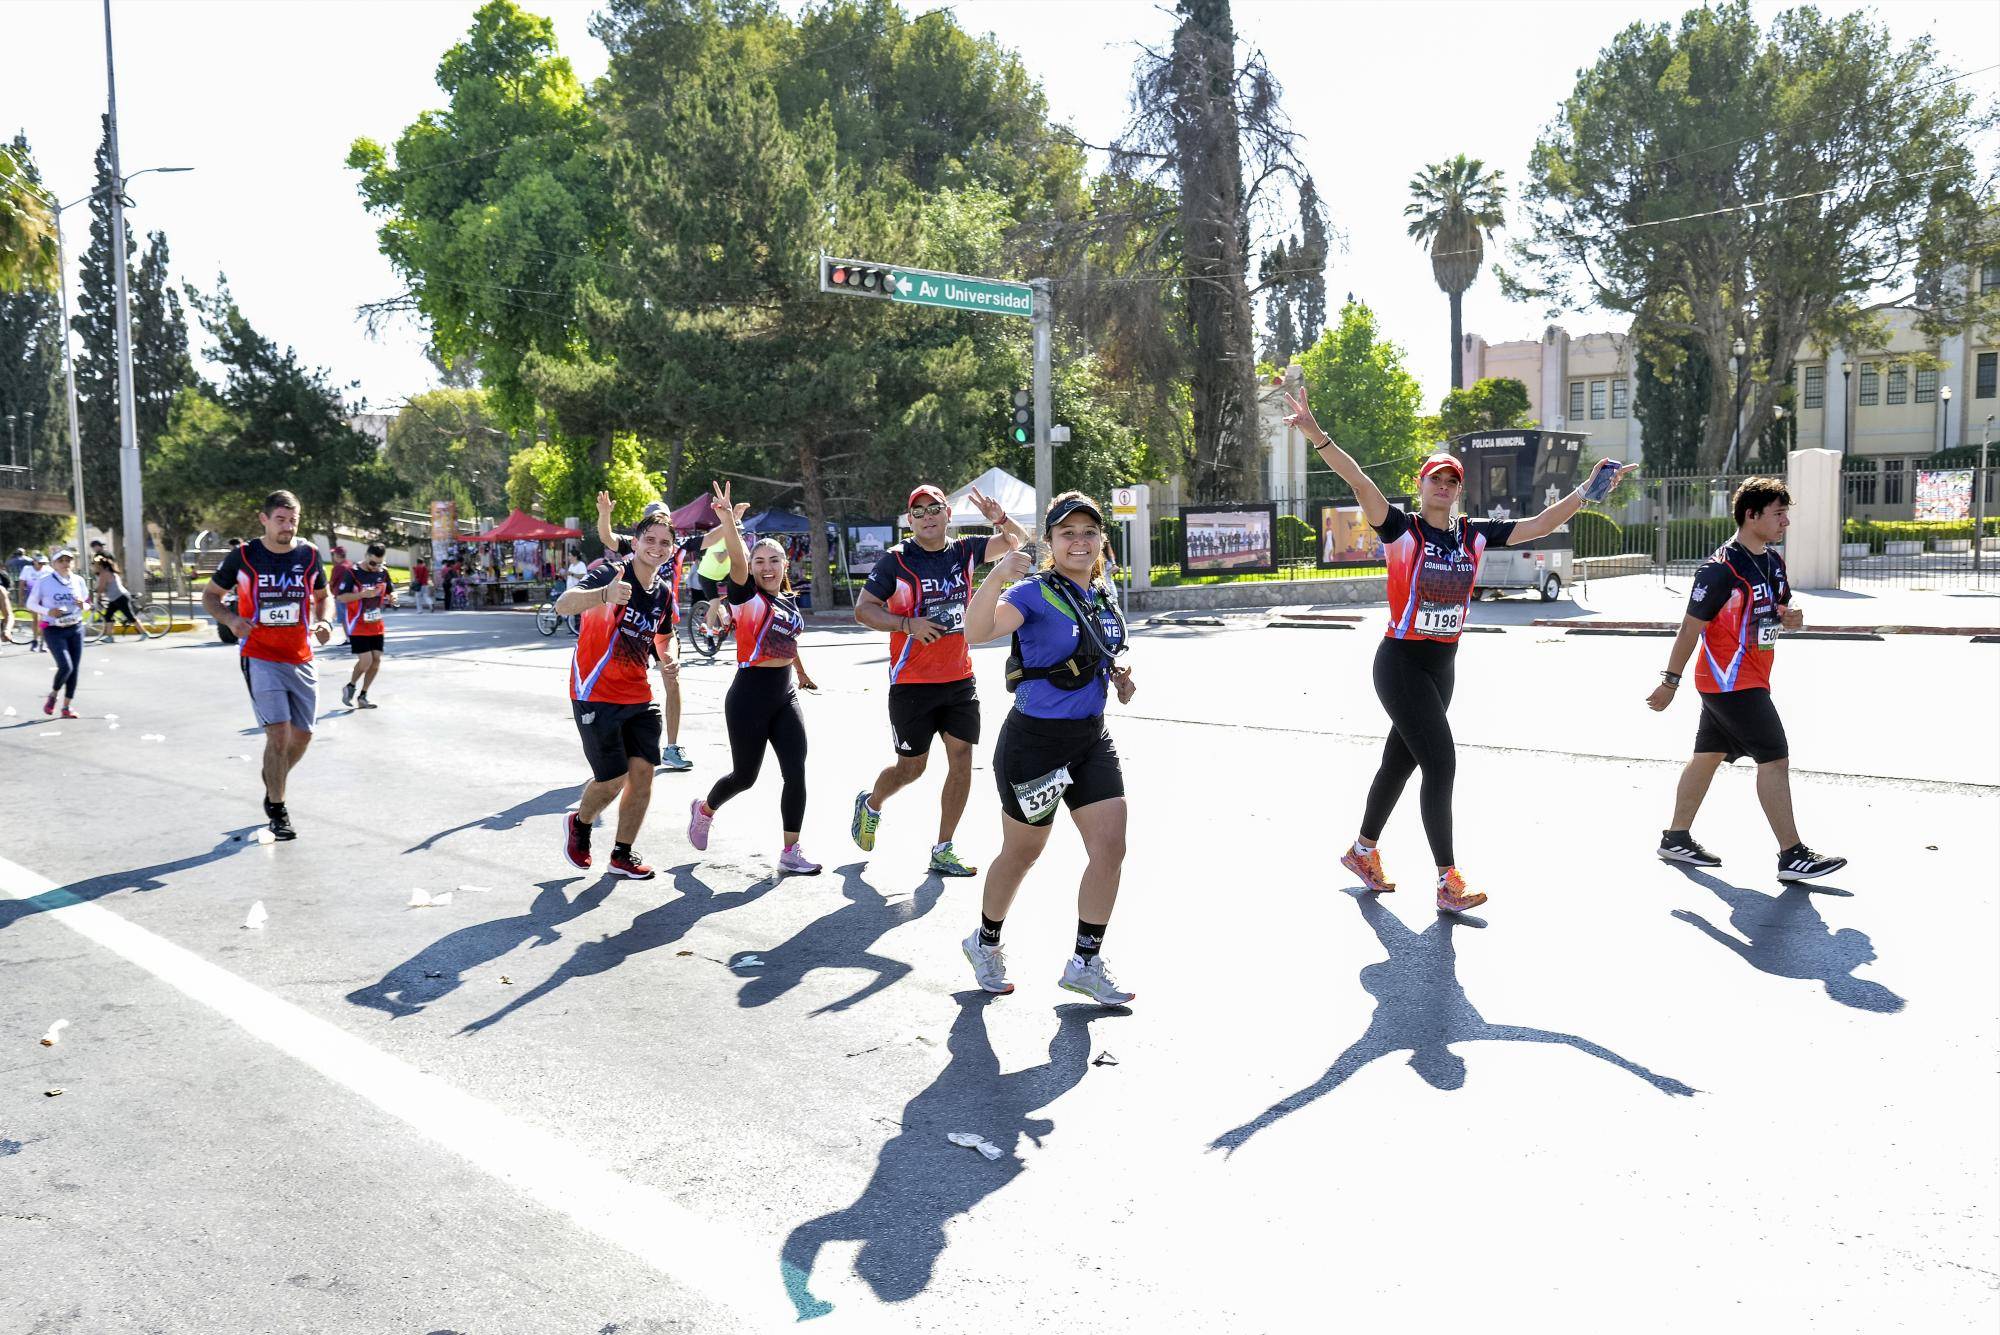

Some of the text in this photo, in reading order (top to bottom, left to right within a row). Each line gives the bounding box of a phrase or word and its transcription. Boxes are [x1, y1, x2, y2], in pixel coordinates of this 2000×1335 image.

[919, 280, 1029, 310] Av Universidad
[1471, 436, 1526, 449] POLICIA MUNICIPAL
[1424, 561, 1473, 572] COAHUILA 2023
[269, 609, 290, 620] 641
[1424, 612, 1457, 628] 1198
